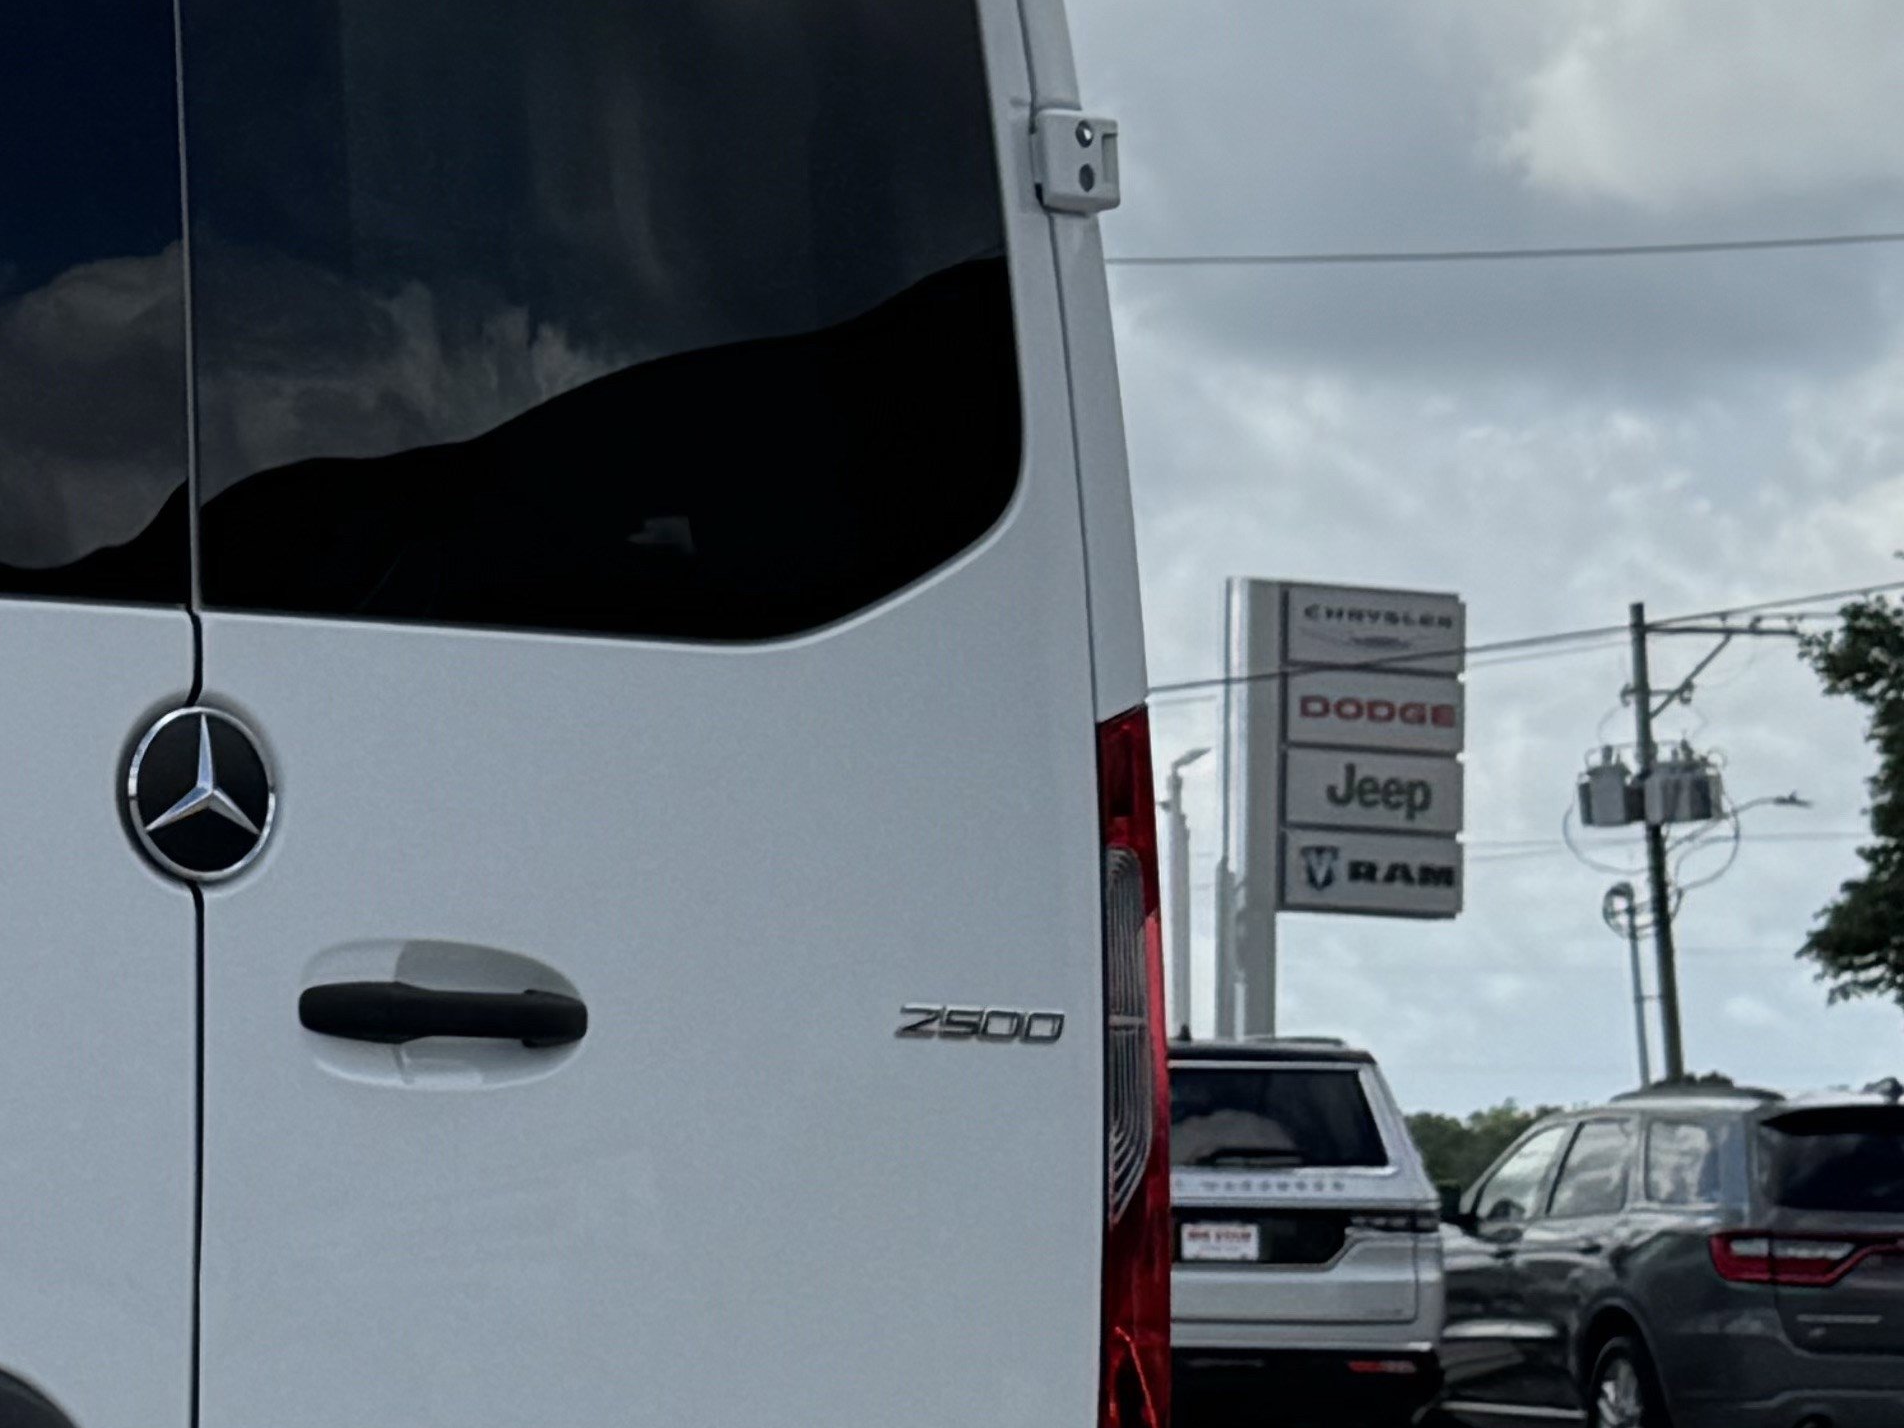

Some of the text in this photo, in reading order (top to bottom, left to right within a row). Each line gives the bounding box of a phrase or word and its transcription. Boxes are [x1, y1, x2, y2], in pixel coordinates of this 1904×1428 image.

[1304, 603, 1453, 629] CHRYSLER
[1299, 694, 1456, 728] DODGE
[1326, 763, 1433, 820] Jeep
[1347, 859, 1454, 887] RAM
[895, 1002, 1065, 1043] 2500
